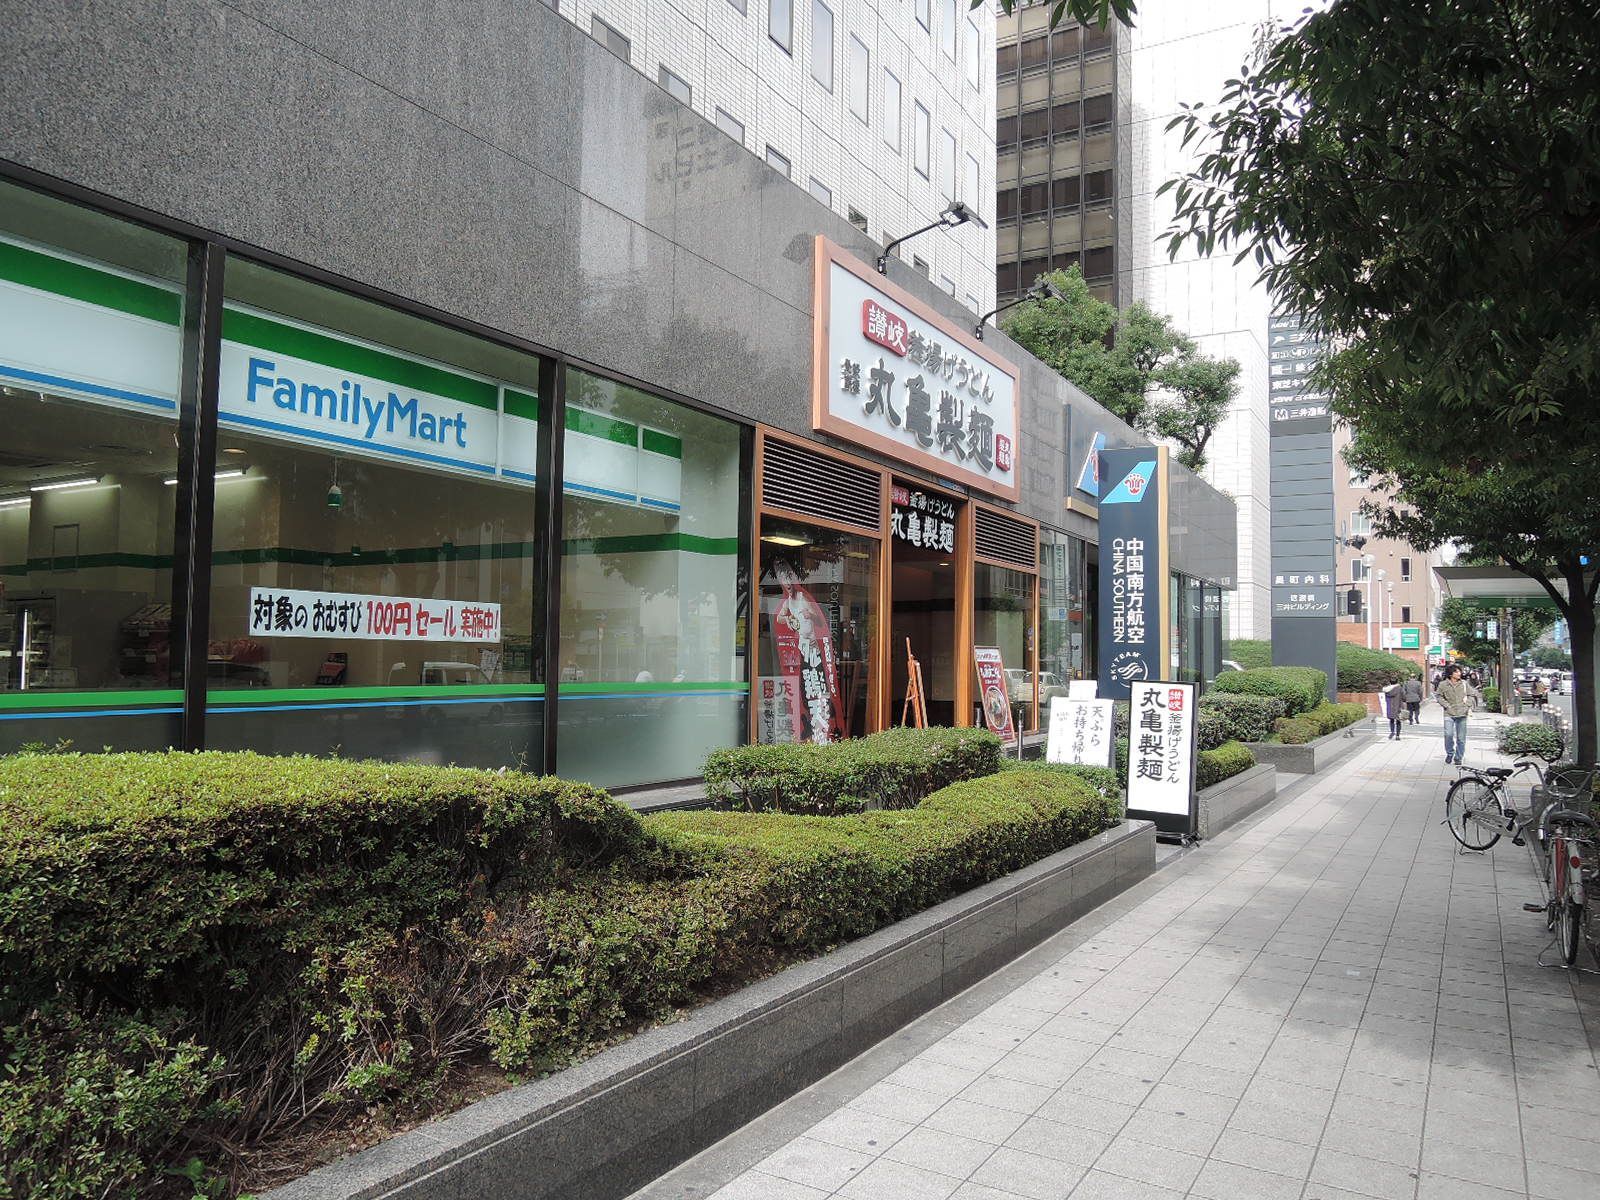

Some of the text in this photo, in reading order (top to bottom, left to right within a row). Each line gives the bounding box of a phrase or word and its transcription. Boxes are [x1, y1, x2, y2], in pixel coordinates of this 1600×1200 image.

[868, 304, 906, 353] 讃岐
[909, 329, 994, 404] 釜揚げうどん
[247, 357, 467, 448] FamilyMart
[864, 357, 994, 473] 丸亀製麺
[891, 508, 954, 553] 丸亀製麺
[910, 491, 954, 519] 釜揚げうどん
[253, 594, 308, 632] 対象の
[312, 598, 362, 633] おむすび
[366, 601, 412, 636] 100円
[415, 603, 457, 637] セール
[1113, 538, 1124, 643] CHINA SOUTHERN
[1126, 538, 1144, 644] 中国南方航空
[1111, 652, 1141, 680] SKYTEAM
[1137, 688, 1166, 781] 丸亀製麺
[1167, 713, 1183, 784] 釜揚げうどん
